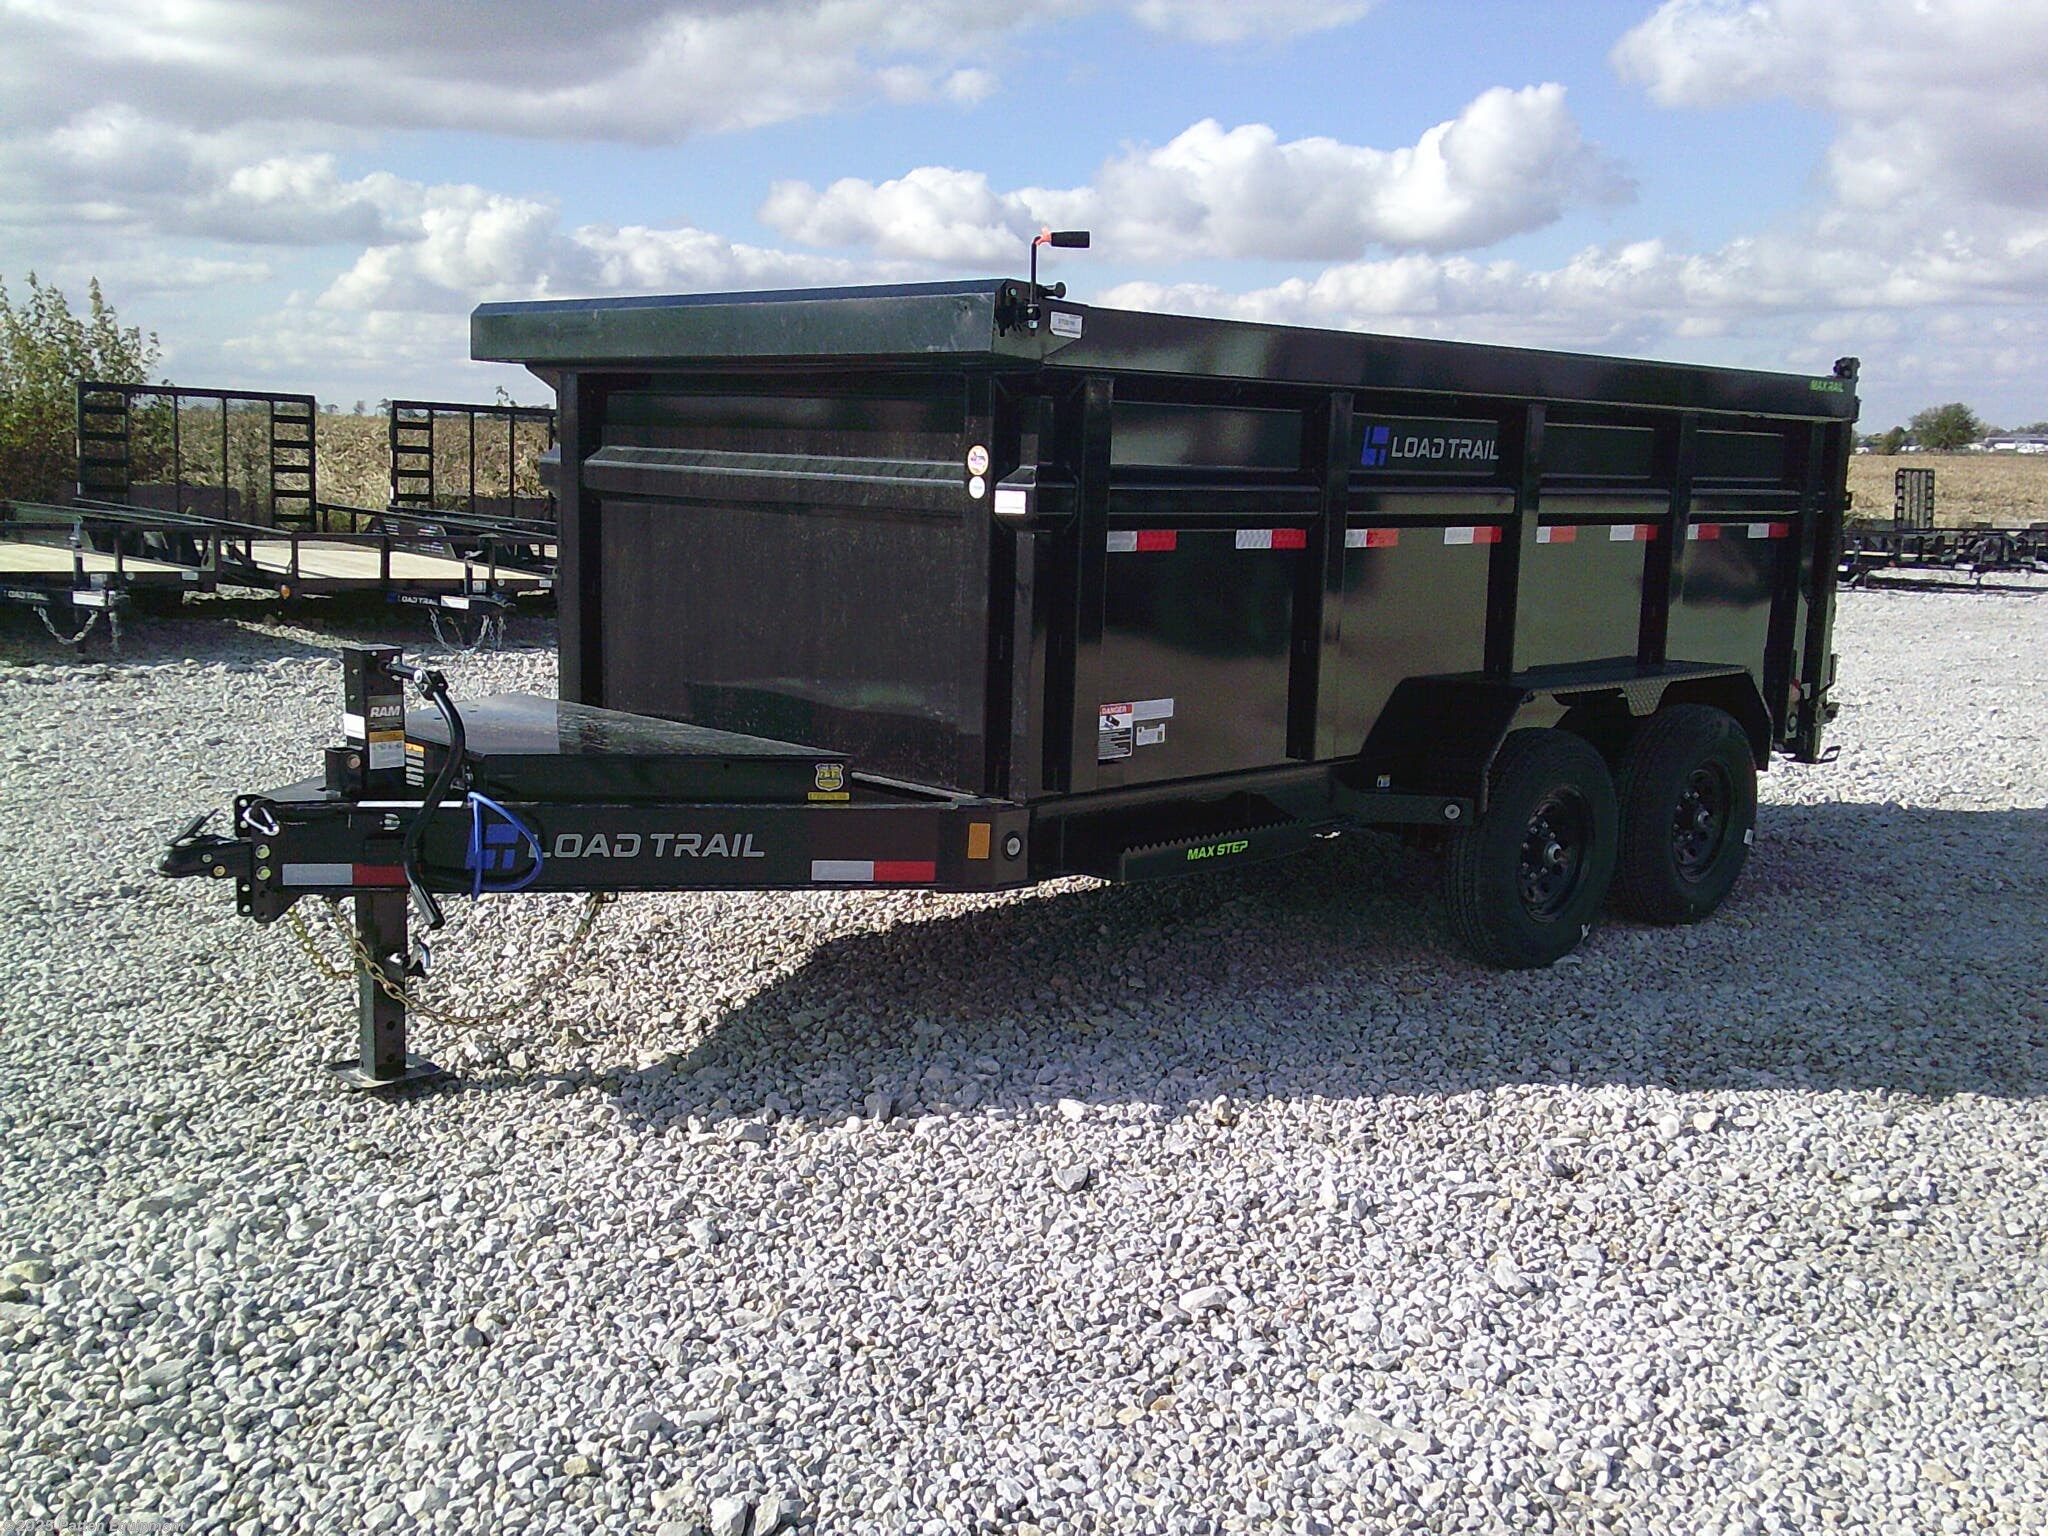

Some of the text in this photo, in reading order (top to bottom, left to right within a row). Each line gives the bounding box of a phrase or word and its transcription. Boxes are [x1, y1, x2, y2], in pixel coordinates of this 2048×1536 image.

[1391, 436, 1500, 460] LOAD TRAIL
[369, 706, 400, 718] RAM
[528, 833, 765, 858] LOAD TRAIL
[1187, 840, 1249, 861] MAX STEP
